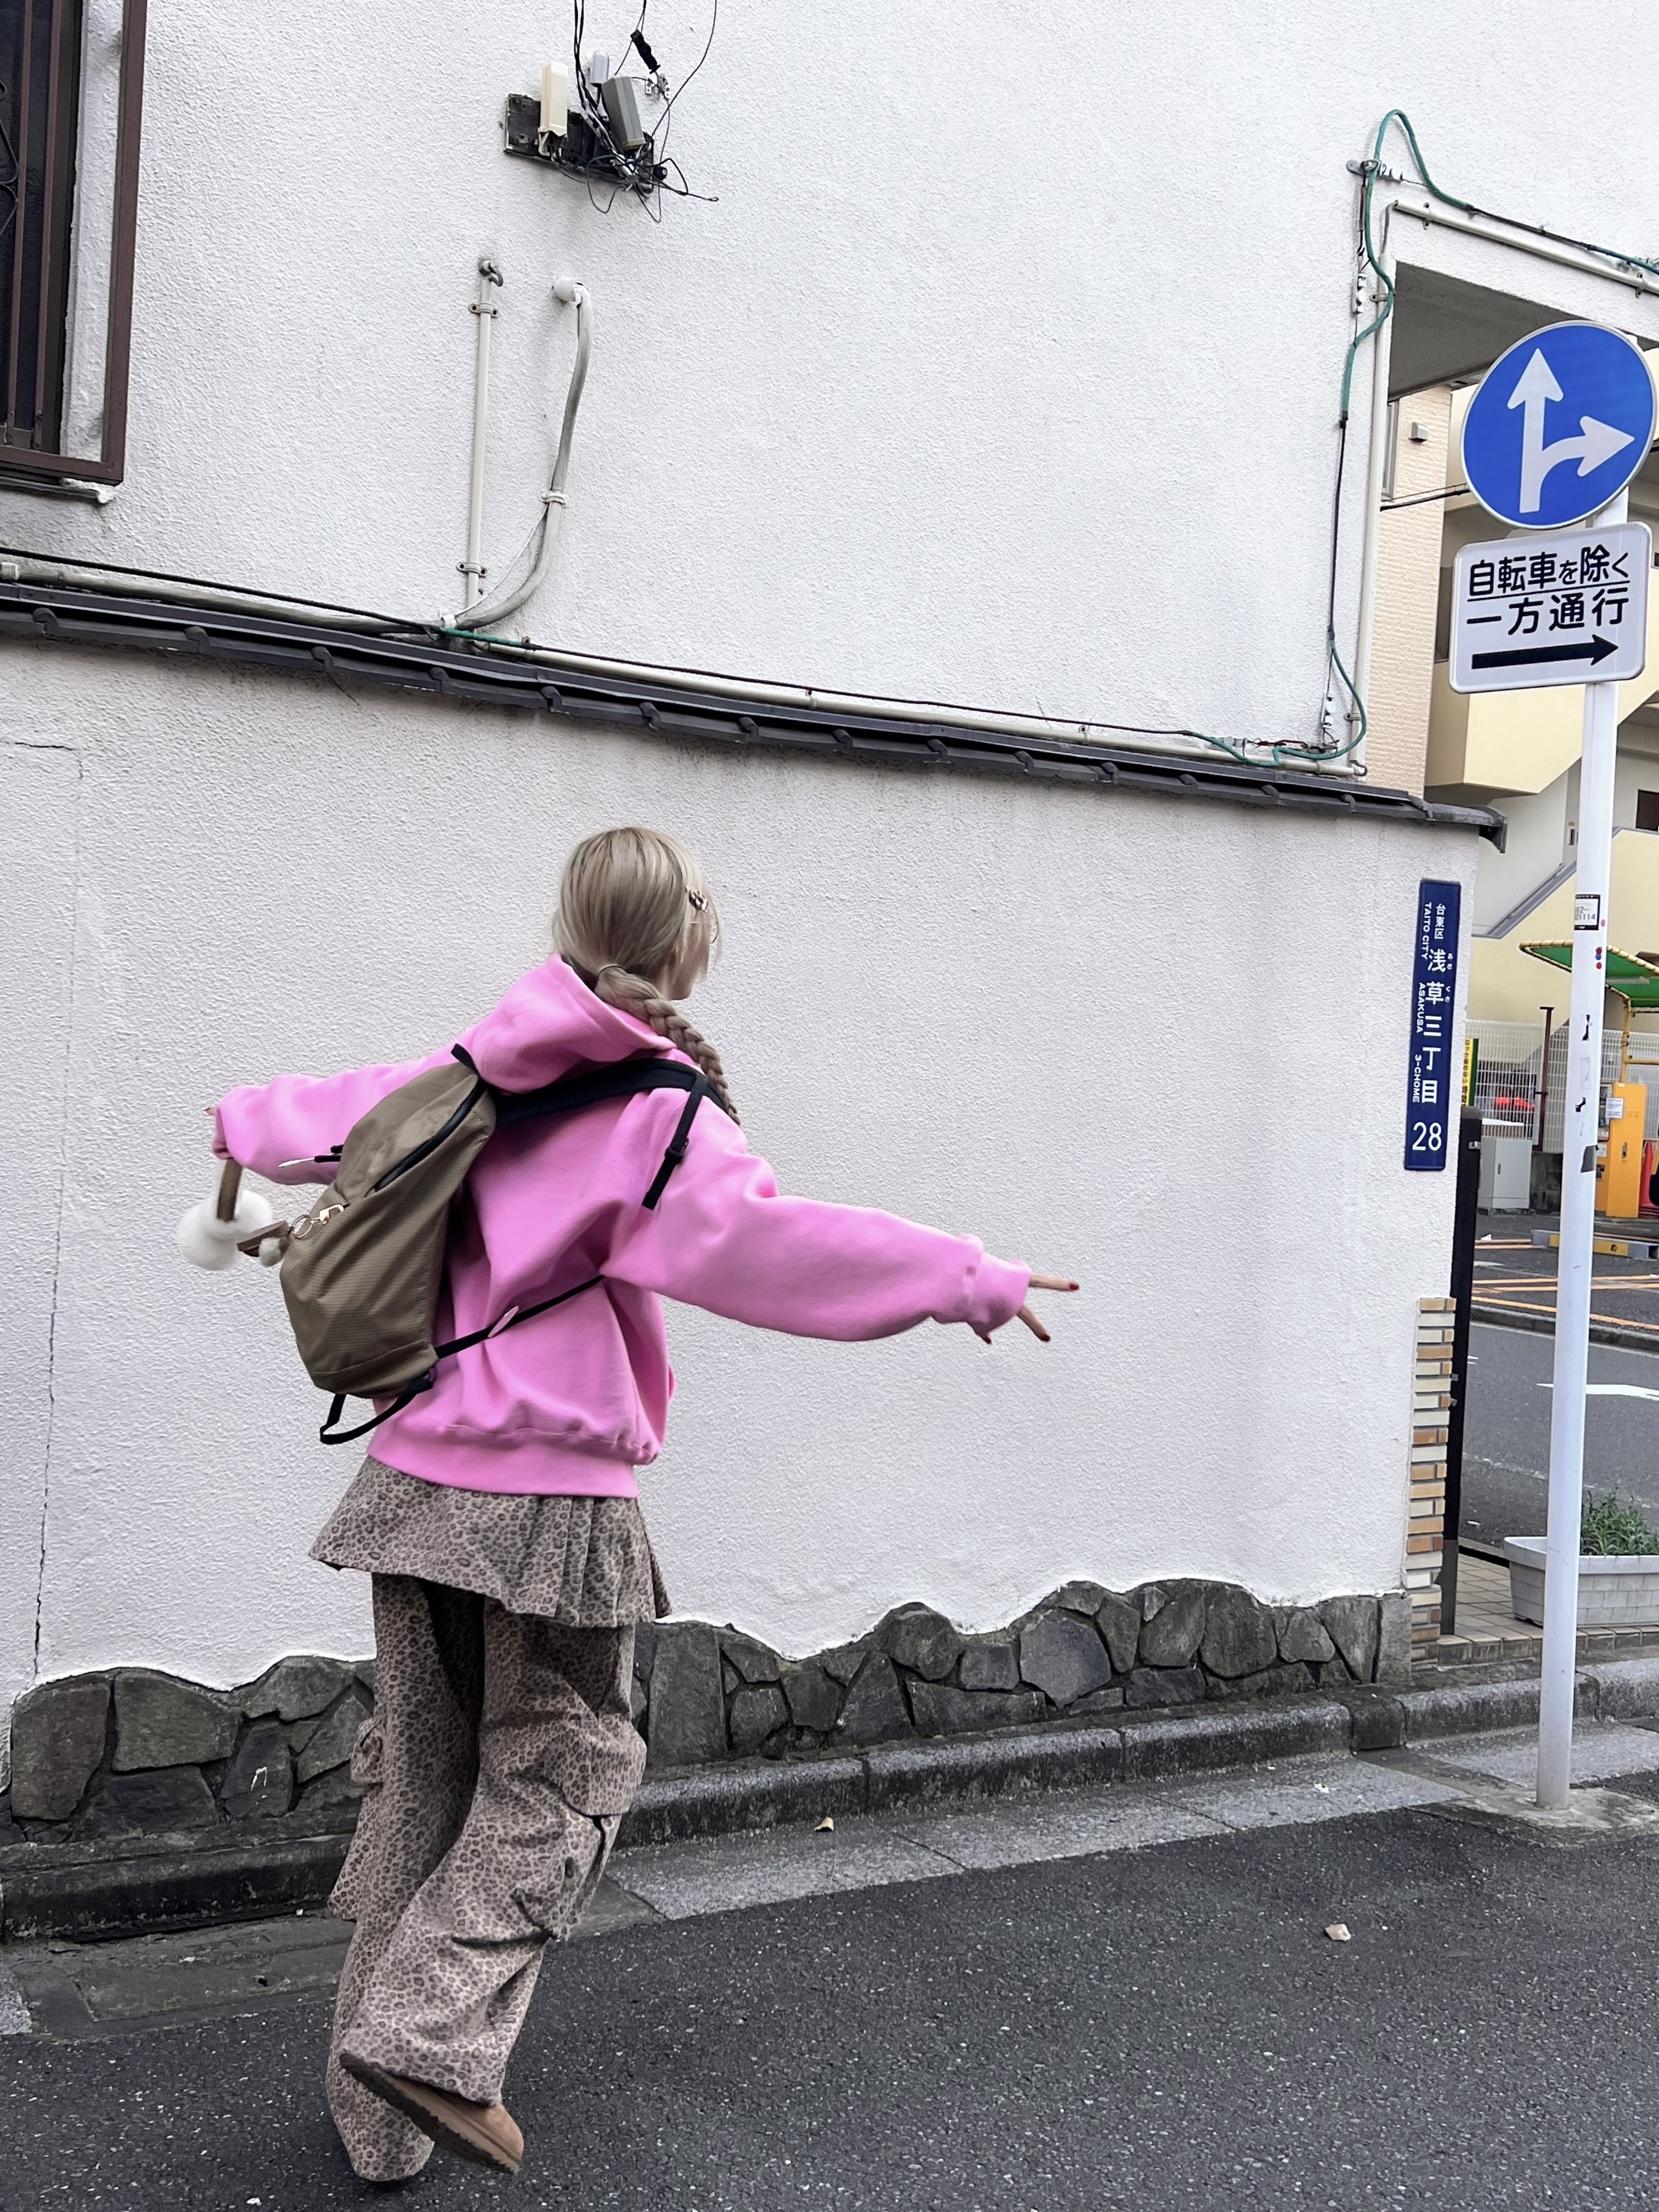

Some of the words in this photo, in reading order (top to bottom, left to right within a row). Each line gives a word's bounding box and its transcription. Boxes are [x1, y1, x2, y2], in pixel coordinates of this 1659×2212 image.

[1470, 545, 1628, 596] 自転車を除く
[1467, 588, 1628, 635] 一方通行
[1423, 902, 1432, 932] TAITO
[1435, 904, 1446, 939] 台東区
[1421, 935, 1430, 960] CITY
[1416, 982, 1426, 1034] ASAKUSA
[1422, 949, 1447, 1103] 浅草三丁目
[1413, 1054, 1422, 1103] 3-CHOME
[1413, 1122, 1442, 1151] 28
